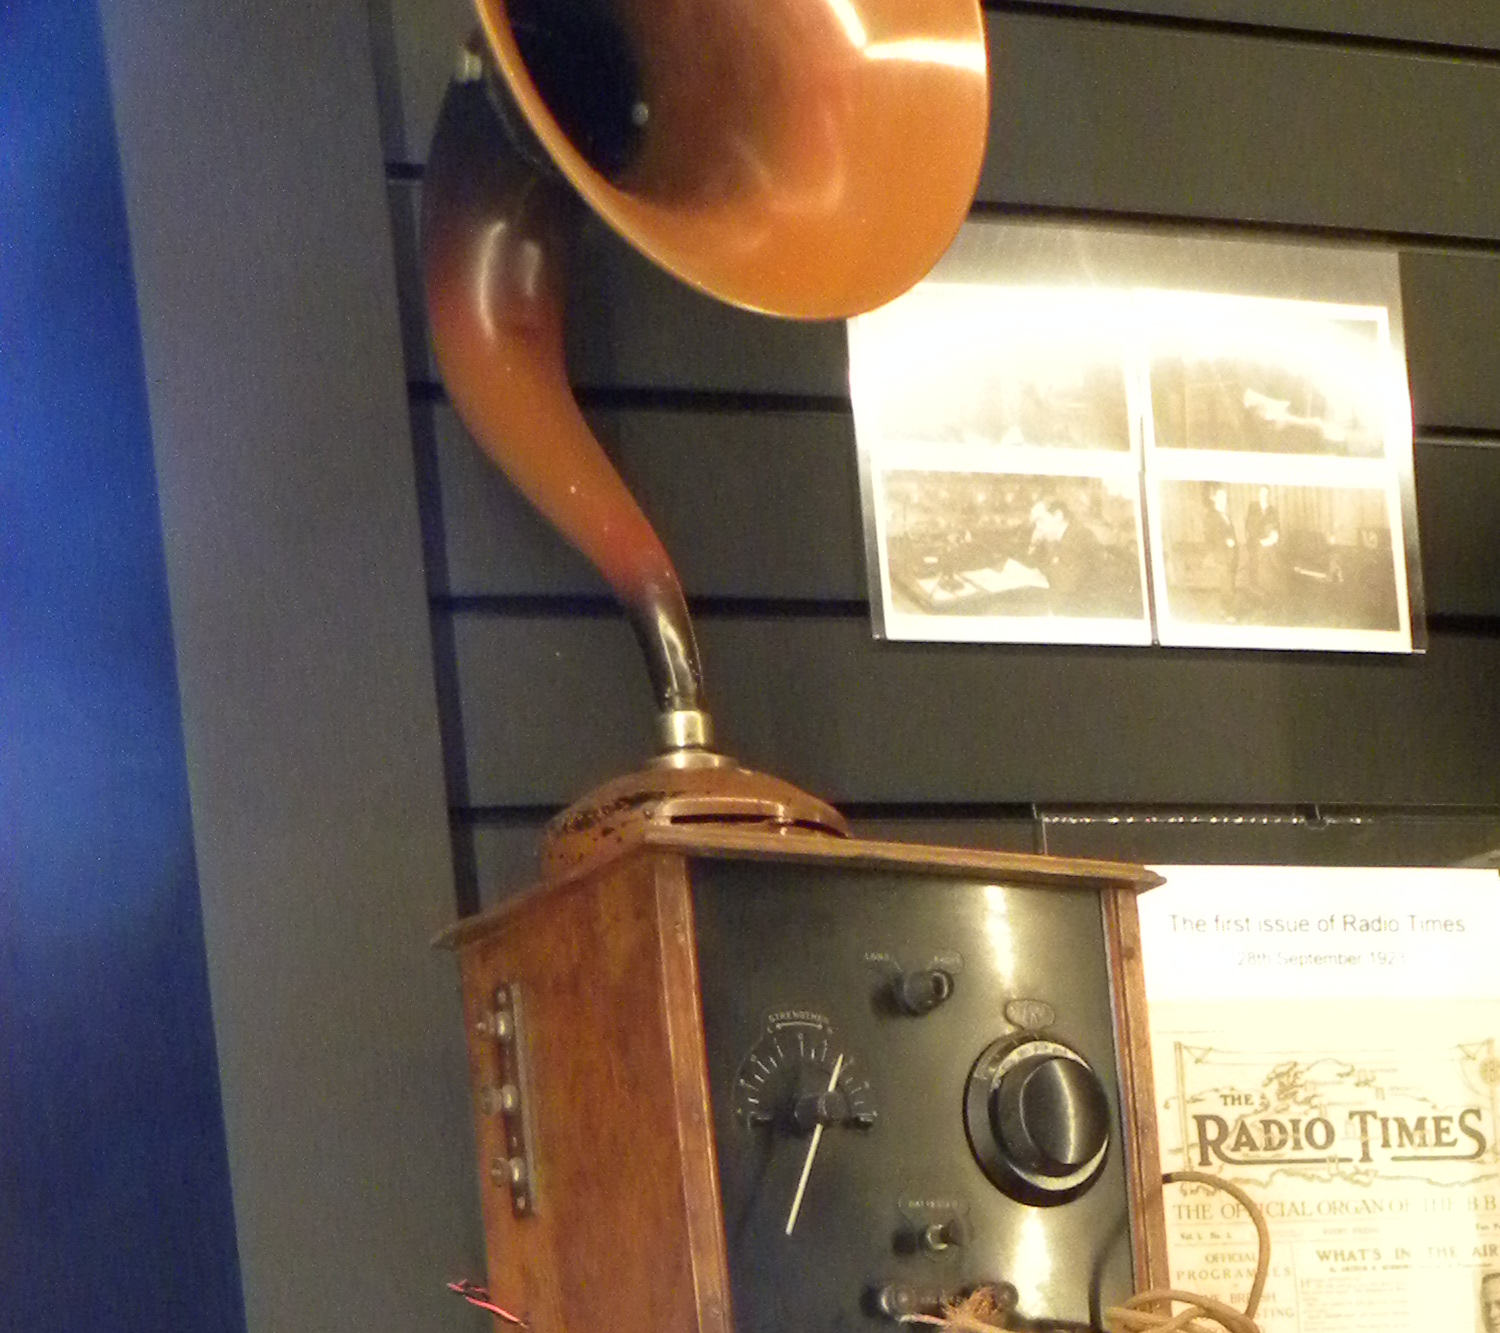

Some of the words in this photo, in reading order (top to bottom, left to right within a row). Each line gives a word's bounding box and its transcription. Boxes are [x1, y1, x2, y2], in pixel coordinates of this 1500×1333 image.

[1170, 914, 1206, 932] The
[1214, 914, 1250, 932] first
[1258, 915, 1310, 933] issue
[1317, 914, 1336, 933] of
[1343, 914, 1400, 933] Radio
[1408, 914, 1466, 933] Times
[1277, 951, 1362, 967] September
[1220, 1093, 1254, 1107] THE
[1193, 1113, 1340, 1167] RADIO
[1349, 1108, 1488, 1163] TIMES
[1172, 1203, 1214, 1221] THE
[1221, 1201, 1313, 1220] OFICIAL
[1317, 1198, 1384, 1216] ORGAN
[1315, 1248, 1382, 1262] WHAT'S
[1395, 1248, 1411, 1260] IN
